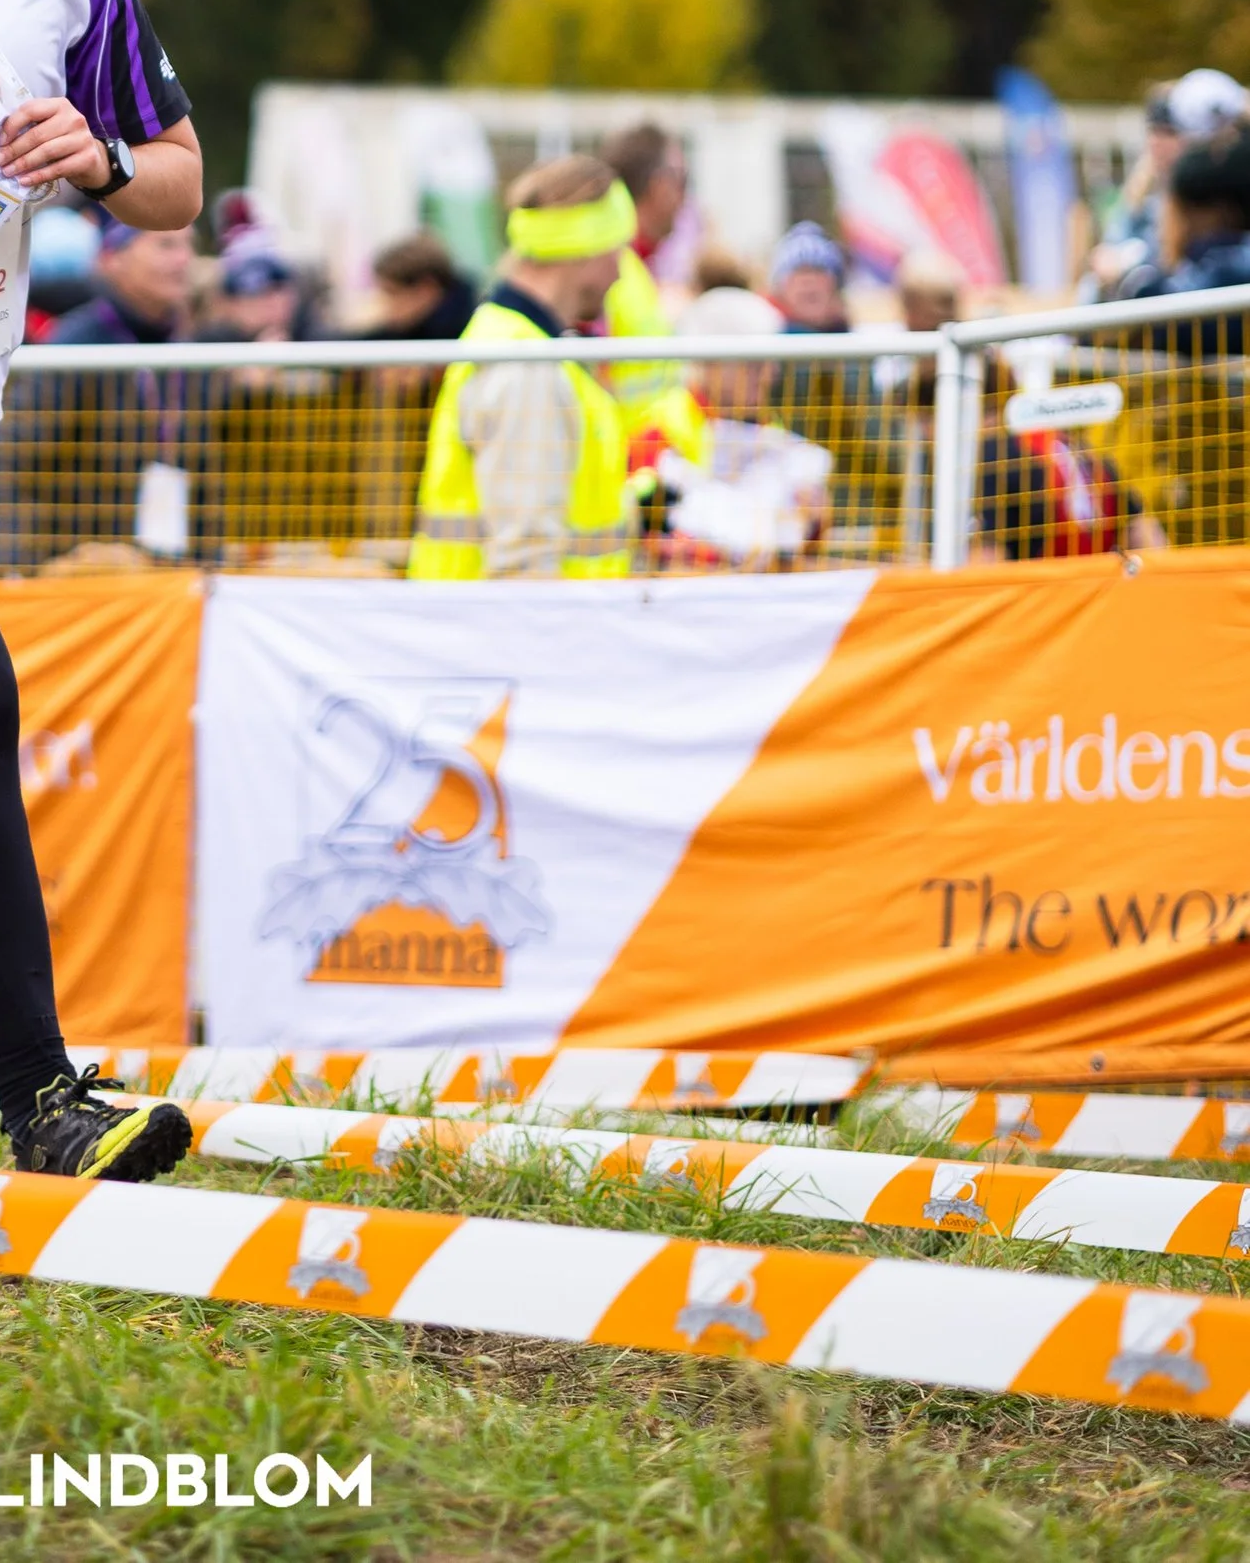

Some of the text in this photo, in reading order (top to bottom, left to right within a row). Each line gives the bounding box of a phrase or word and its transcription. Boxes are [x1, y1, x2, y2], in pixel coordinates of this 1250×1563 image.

[314, 692, 498, 853] 25
[911, 713, 1250, 805] Världens
[317, 930, 500, 975] manna
[917, 872, 1073, 957] The
[936, 1165, 980, 1203] 25
